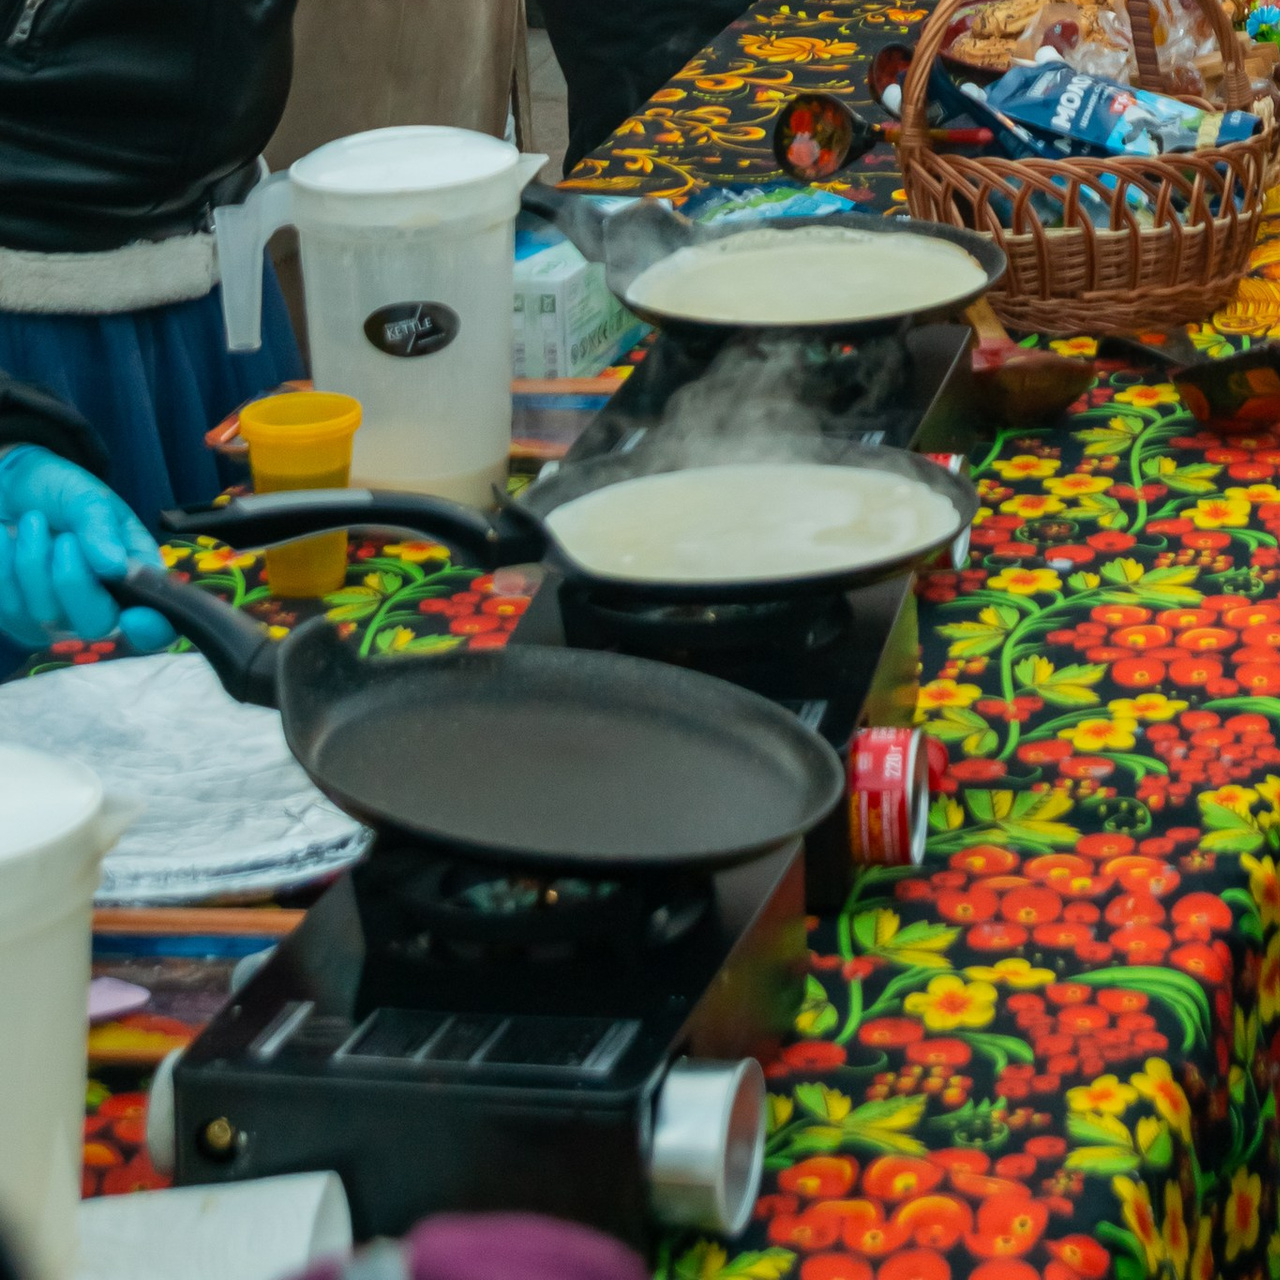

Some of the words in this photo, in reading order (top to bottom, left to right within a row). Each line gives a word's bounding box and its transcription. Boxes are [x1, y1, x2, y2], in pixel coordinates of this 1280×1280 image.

[1050, 73, 1096, 132] МОЛО
[385, 316, 433, 341] KETTLE
[884, 753, 903, 778] 220
